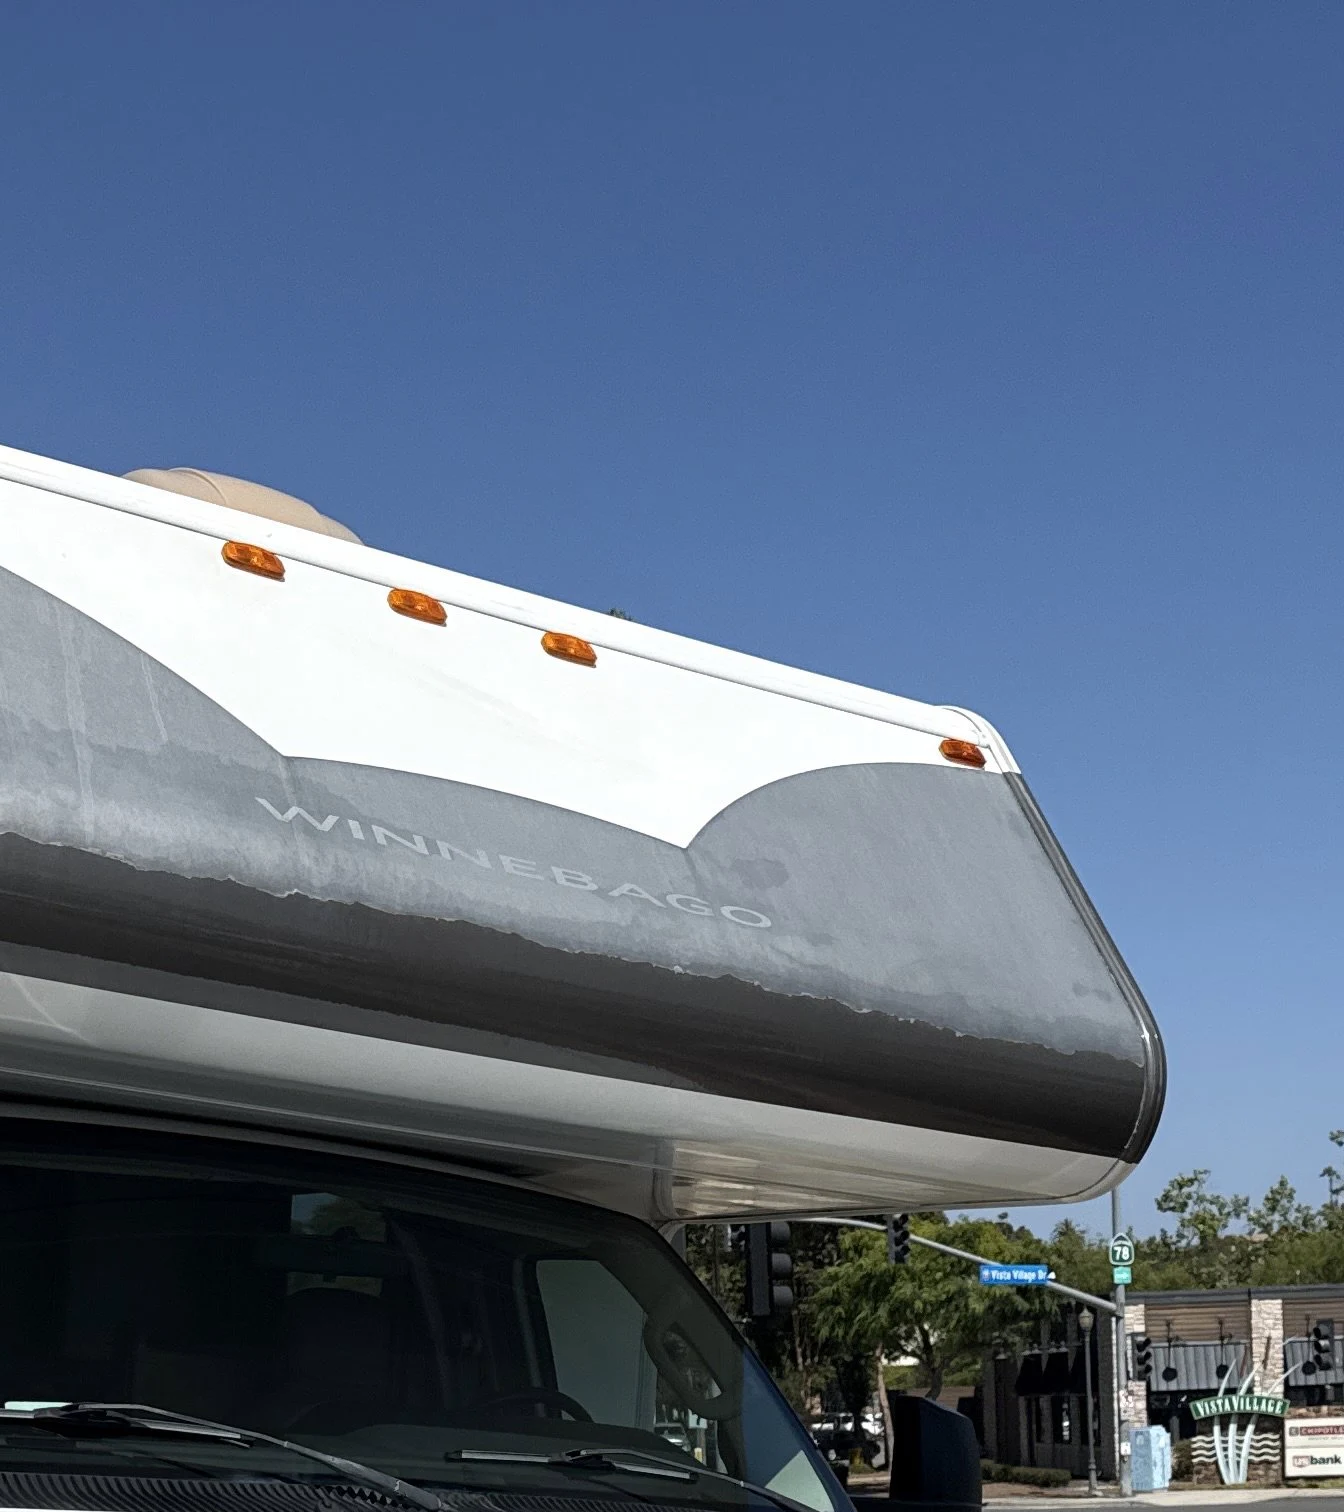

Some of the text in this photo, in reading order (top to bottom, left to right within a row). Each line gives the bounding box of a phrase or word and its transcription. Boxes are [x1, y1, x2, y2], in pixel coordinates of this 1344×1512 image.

[254, 797, 772, 929] WINNEBAGO
[1113, 1246, 1130, 1260] 78
[991, 1271, 1012, 1281] Vista
[1013, 1269, 1037, 1283] Village
[1196, 1394, 1284, 1417] VISTA VILLAGE
